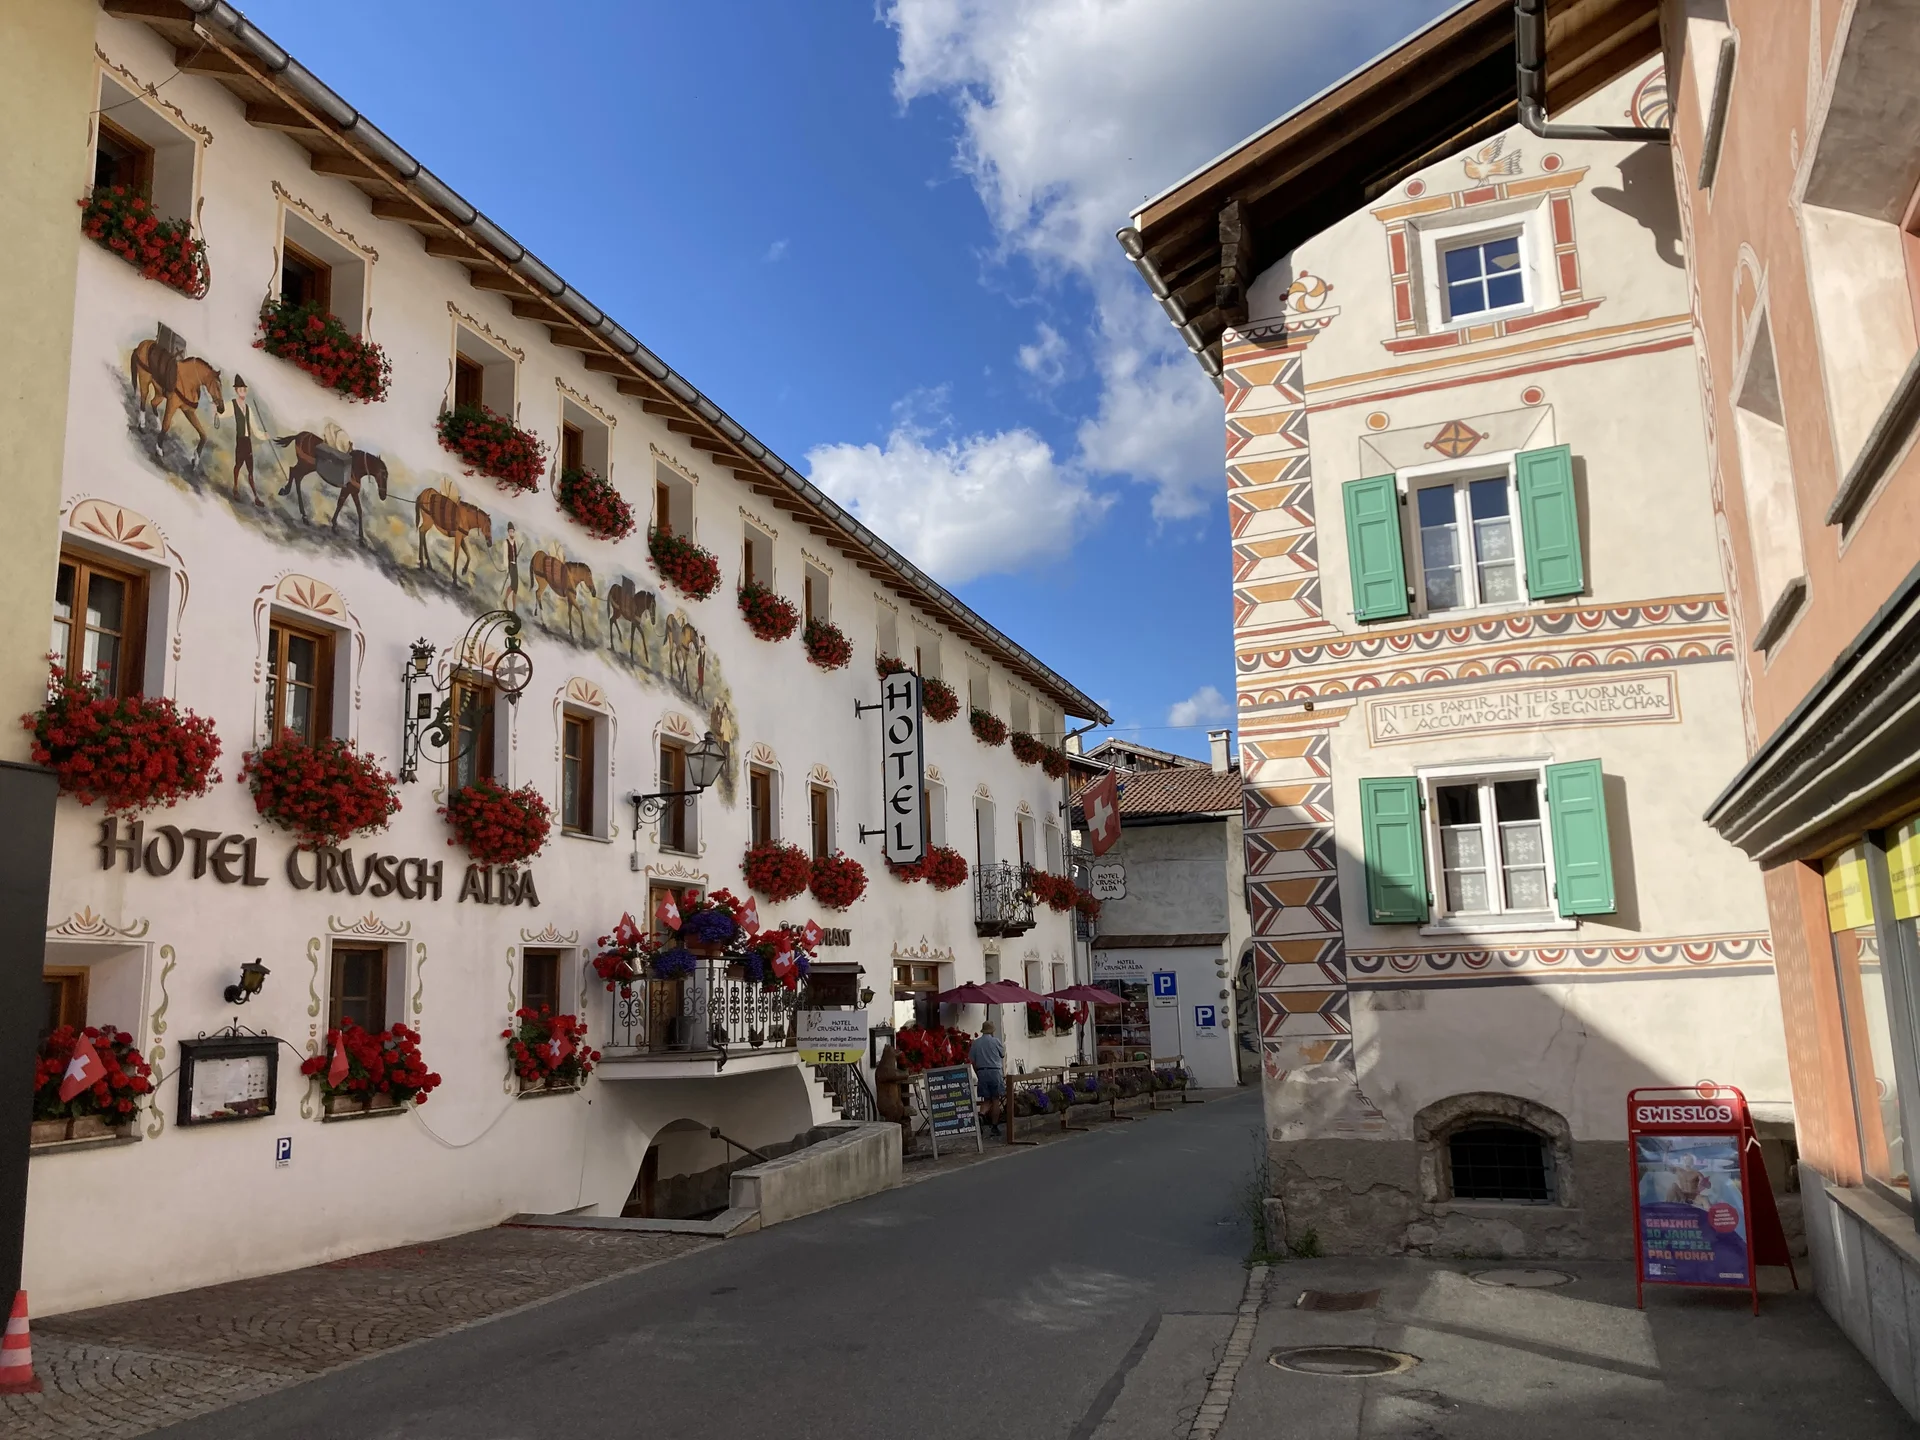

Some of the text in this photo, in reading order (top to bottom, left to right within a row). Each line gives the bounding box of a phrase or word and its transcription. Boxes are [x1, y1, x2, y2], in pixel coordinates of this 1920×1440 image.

[1380, 706, 1397, 721] IN
[1400, 703, 1434, 718] TEIS
[1500, 694, 1519, 707] IN
[1523, 690, 1558, 704] TEIS
[1565, 684, 1650, 700] TUORNAR
[1528, 706, 1540, 718] IL
[1550, 698, 1621, 715] SEGNER
[1623, 695, 1669, 710] CHAR
[884, 681, 914, 850] HOTEL
[96, 816, 269, 886] HOTEL
[459, 864, 540, 907] ALBA
[1160, 976, 1171, 993] P
[1197, 1008, 1212, 1025] P
[818, 1052, 845, 1062] FREI
[1638, 1106, 1731, 1122] SWISSLOS
[278, 1140, 290, 1159] P
[1675, 1251, 1715, 1261] MONAT
